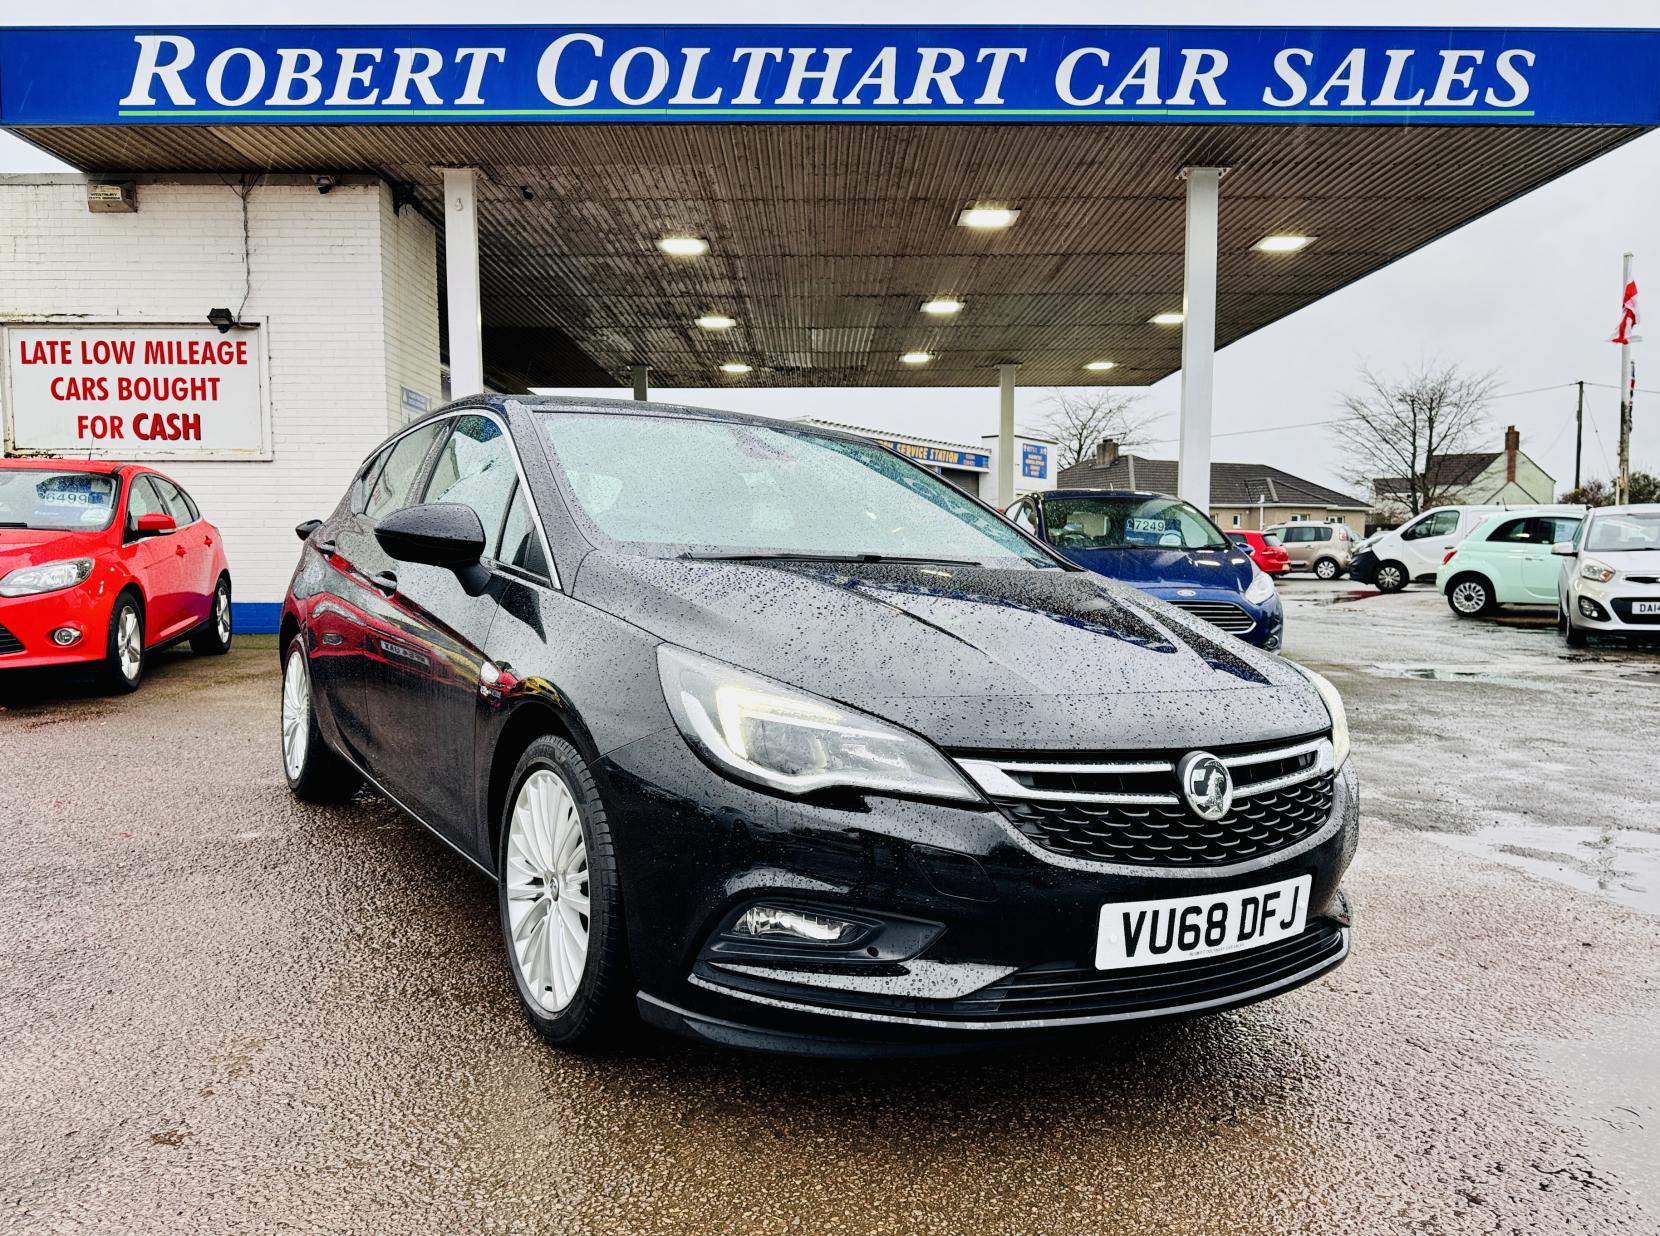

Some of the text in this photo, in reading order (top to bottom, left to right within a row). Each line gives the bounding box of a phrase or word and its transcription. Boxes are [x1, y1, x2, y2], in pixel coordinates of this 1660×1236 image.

[120, 33, 1536, 108] ROBERT COLTHART CAR SALES
[21, 341, 248, 365] LATE LOW MILEAGE
[50, 377, 221, 401] CARS BOUGHT
[77, 413, 202, 441] FOR CASH
[897, 443, 928, 460] SERVICE
[930, 448, 959, 463] STATION
[1122, 885, 1300, 958] VU68 DFJ
